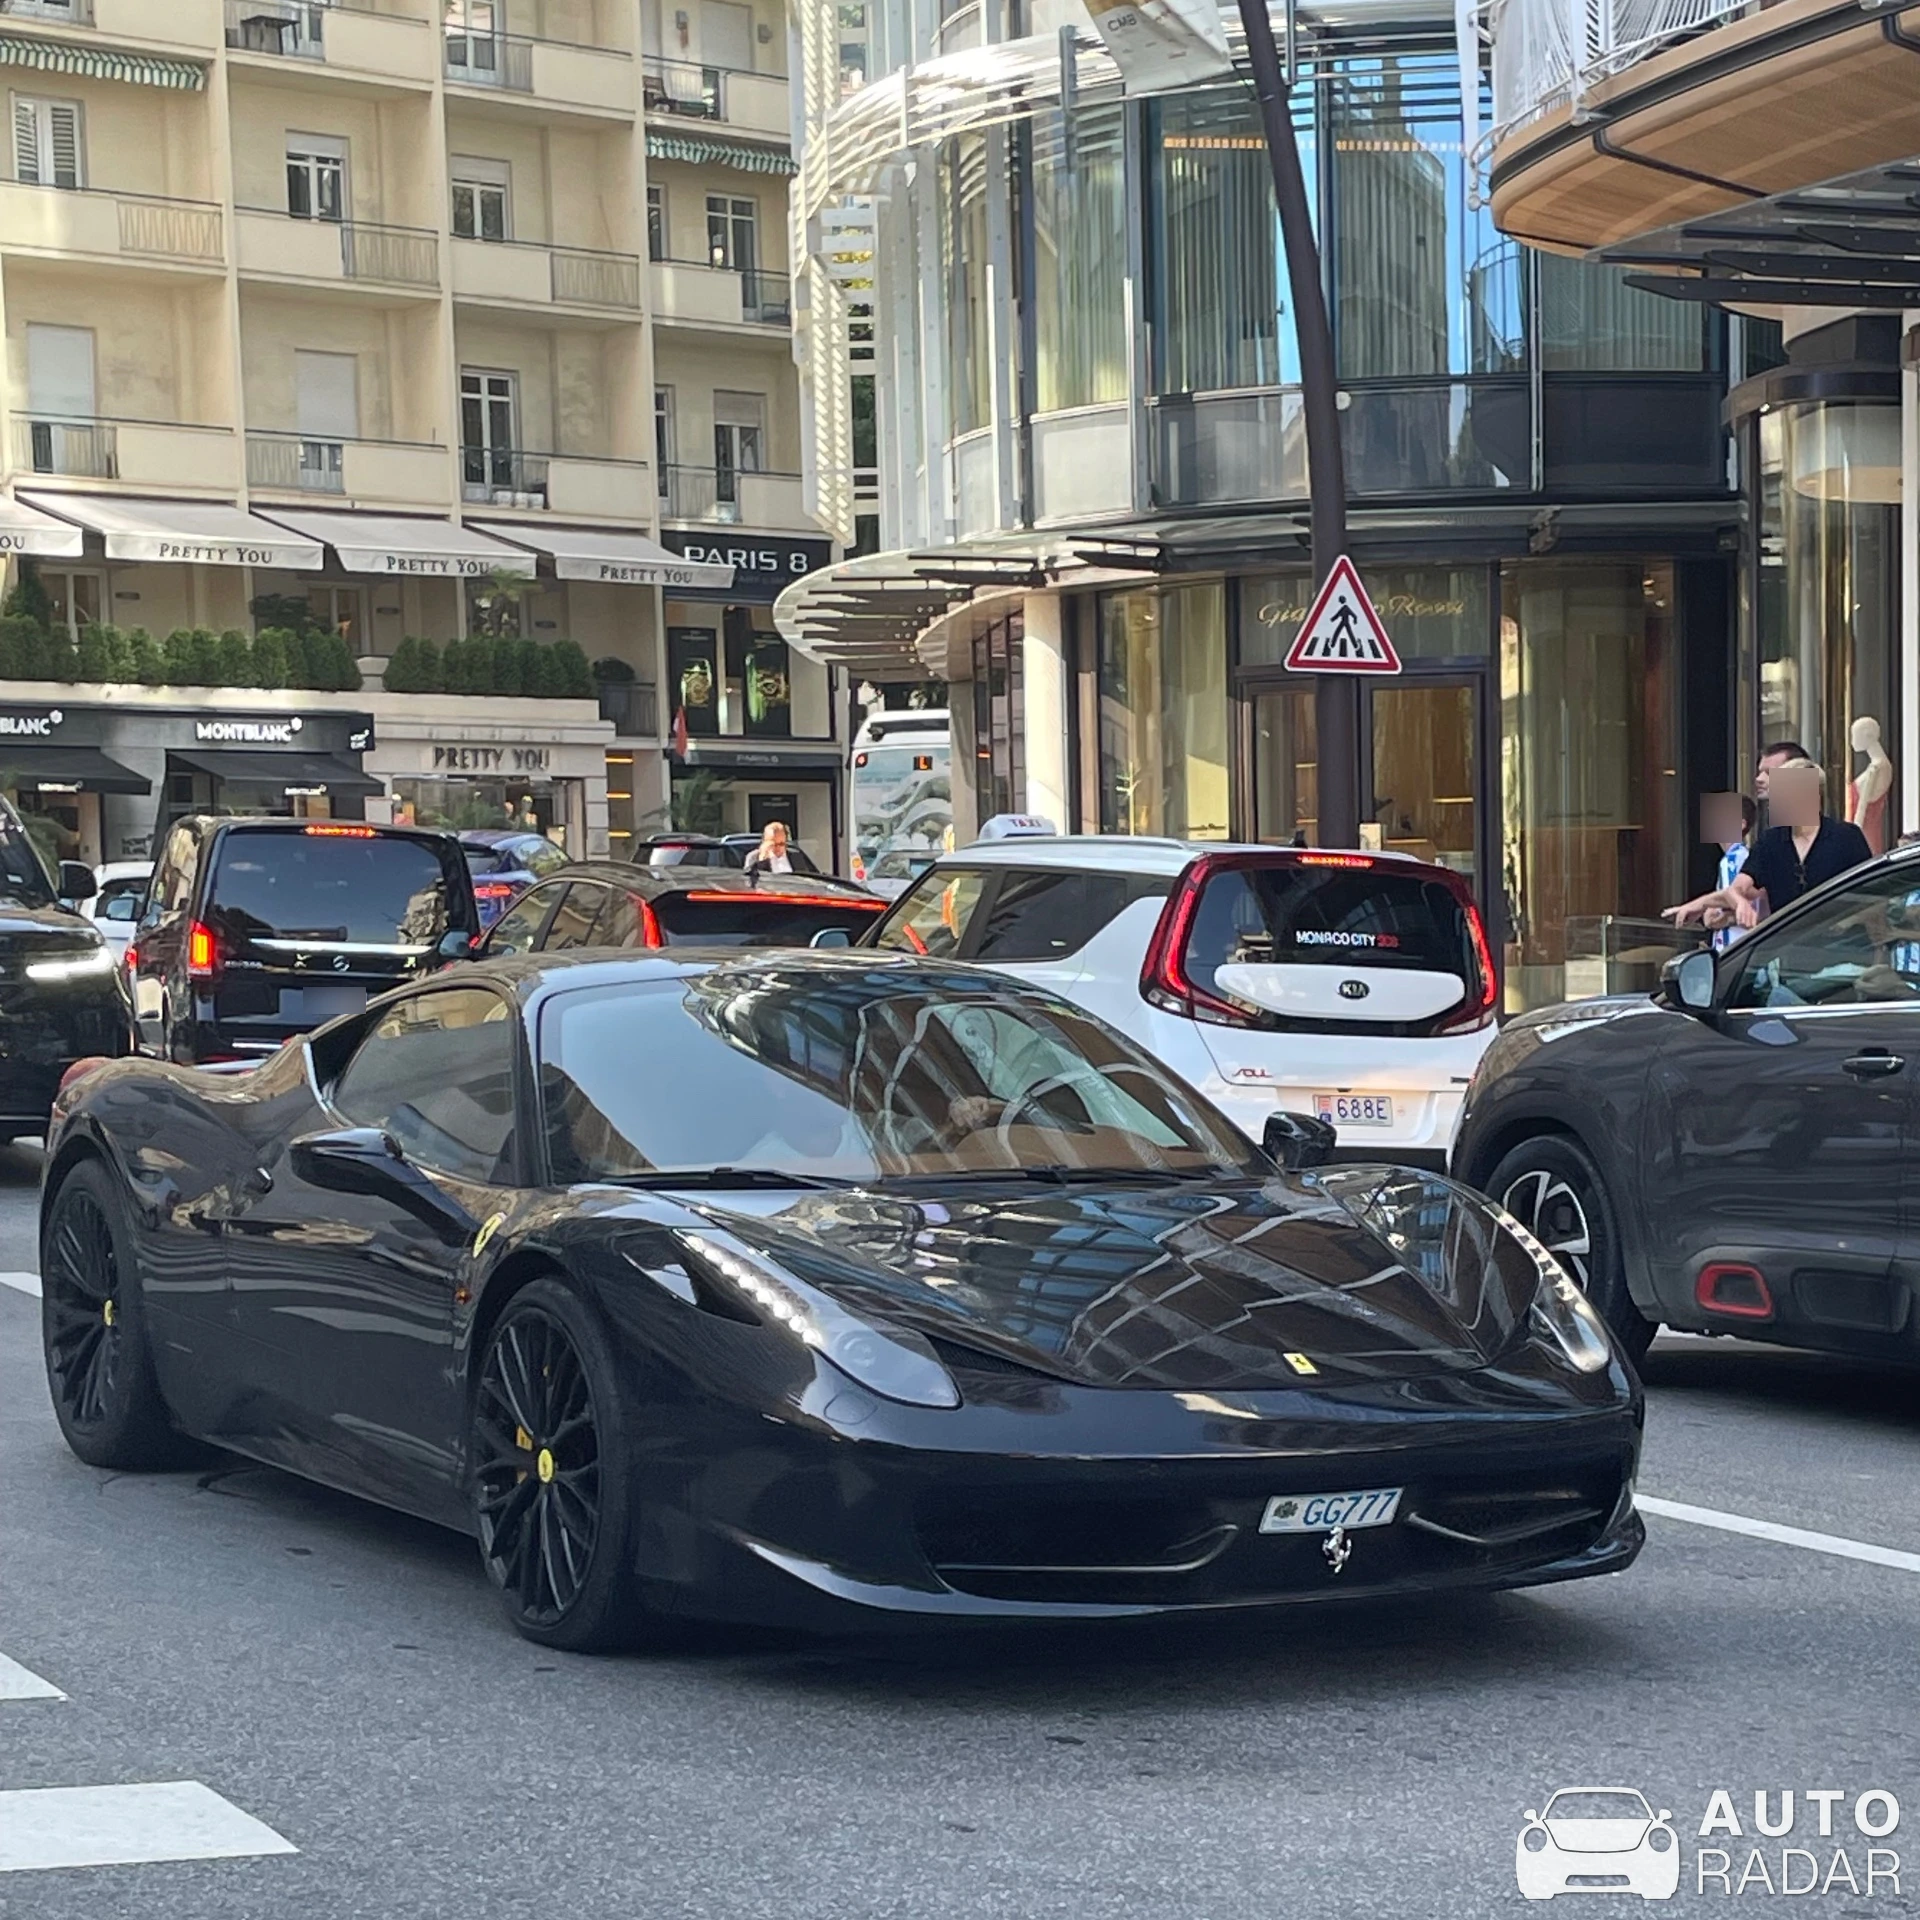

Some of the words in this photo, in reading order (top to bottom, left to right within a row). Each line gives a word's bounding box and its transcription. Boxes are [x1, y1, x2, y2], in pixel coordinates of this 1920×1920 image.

[1107, 13, 1138, 32] CMB
[683, 545, 779, 571] PARIS
[789, 552, 808, 573] 8
[196, 722, 292, 741] MONTBLANC
[433, 747, 504, 770] PRETTY
[512, 748, 550, 771] YOU
[1008, 818, 1042, 828] TAXI
[1296, 930, 1350, 945] MONACO
[1351, 933, 1376, 947] CITY
[1337, 1097, 1388, 1120] 688E
[1303, 1491, 1398, 1526] GG777
